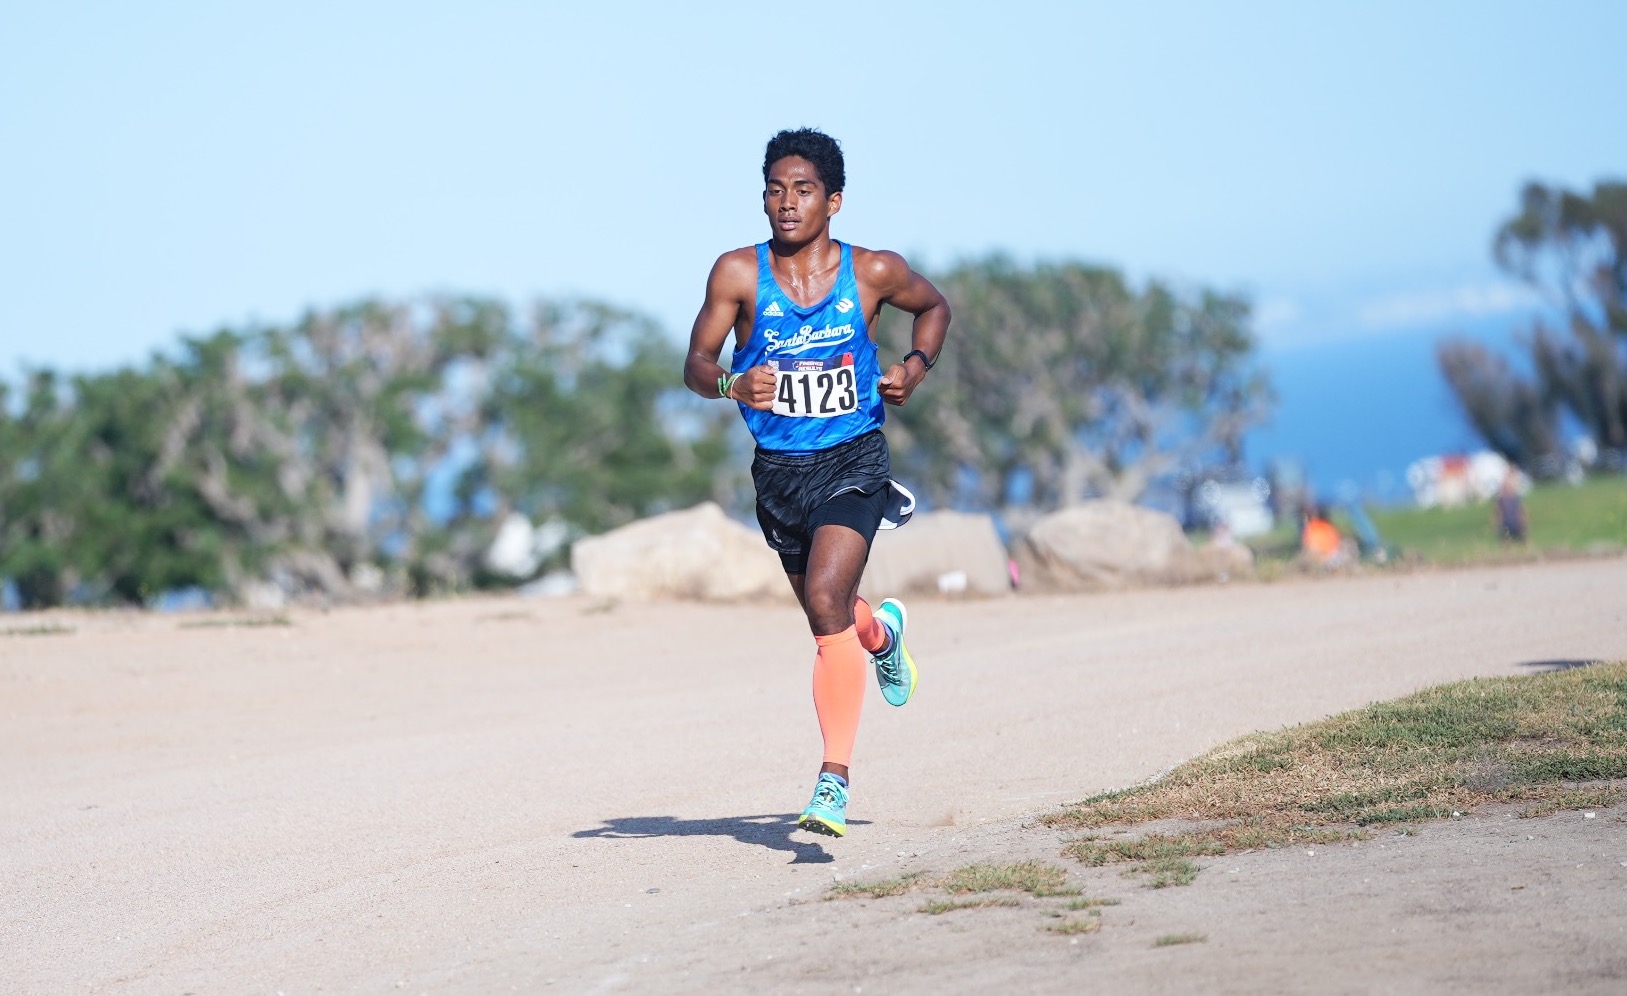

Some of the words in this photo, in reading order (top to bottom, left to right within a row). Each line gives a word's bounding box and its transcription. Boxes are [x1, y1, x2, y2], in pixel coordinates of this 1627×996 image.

[763, 328, 804, 352] Santa
[799, 324, 852, 344] Barbara
[778, 368, 856, 414] 4123
